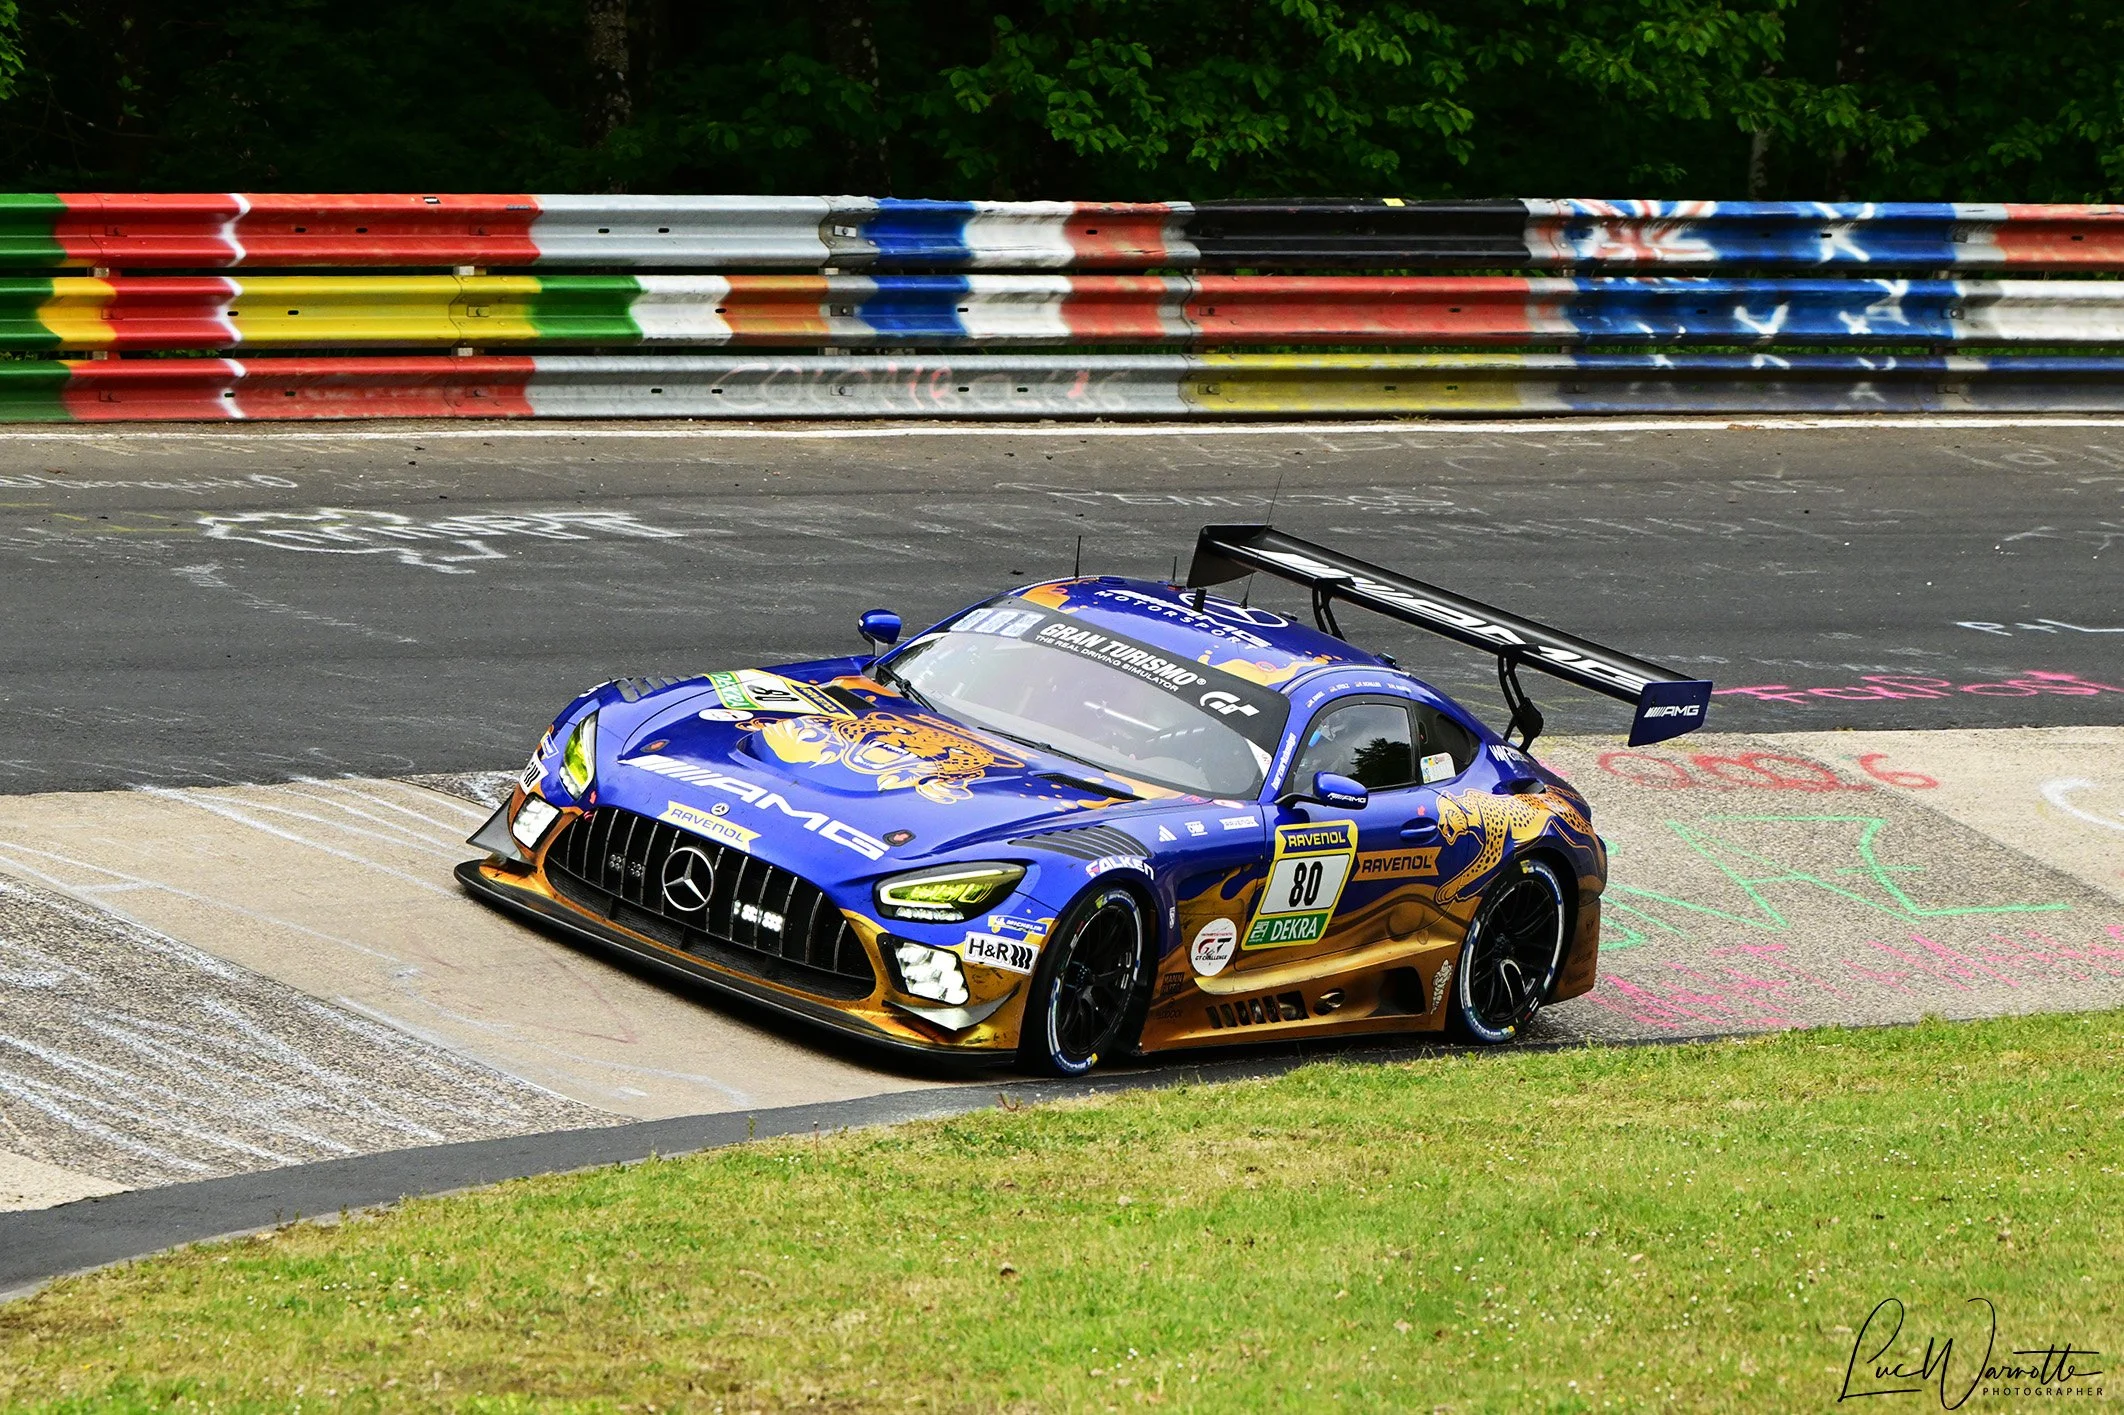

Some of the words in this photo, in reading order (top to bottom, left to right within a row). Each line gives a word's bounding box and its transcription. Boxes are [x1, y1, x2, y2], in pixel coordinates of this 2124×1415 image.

[1094, 590, 1258, 650] MOTORSPORT
[1040, 622, 1103, 650] GRAN
[1035, 634, 1053, 645] THE
[1052, 638, 1080, 653] REAL
[1080, 647, 1122, 667] DRIVING
[1122, 662, 1180, 693] SIMULATOR
[712, 671, 746, 708] DEKRA
[748, 684, 800, 702] 80
[670, 808, 745, 843] RAVENOL
[1287, 831, 1346, 848] RAVENOL
[1084, 856, 1156, 881] FALKEN
[1361, 854, 1433, 874] RAVENOL
[1288, 861, 1324, 908] 80
[1005, 918, 1044, 933] MICHELIN
[1270, 916, 1318, 942] DEKRA
[968, 938, 1010, 962] H&R
